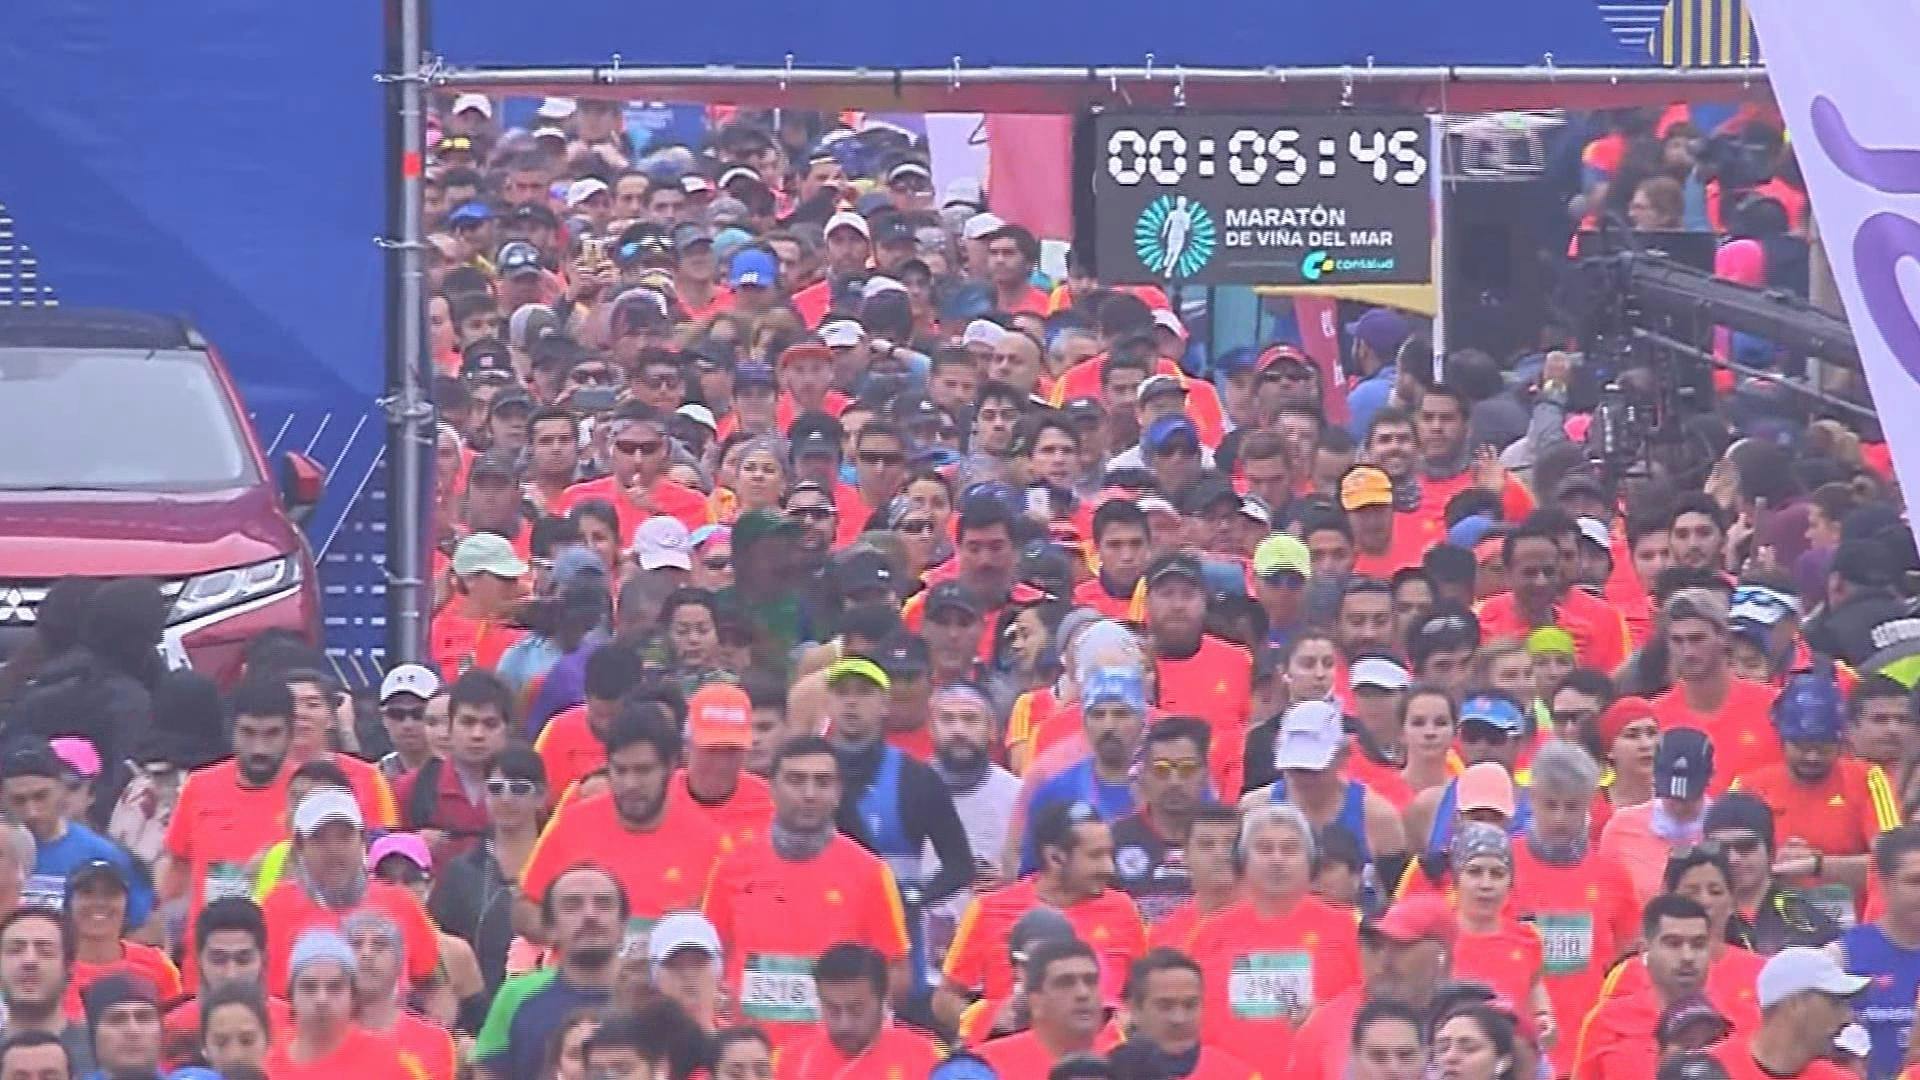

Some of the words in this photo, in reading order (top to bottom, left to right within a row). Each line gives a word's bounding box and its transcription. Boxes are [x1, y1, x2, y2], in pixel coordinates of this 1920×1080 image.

[1107, 130, 1427, 185] 00:05:45
[1225, 203, 1346, 226] MARATÓN
[1225, 230, 1252, 247] DE
[1256, 228, 1305, 247] VIÑA
[1308, 230, 1346, 247] DEL
[1349, 230, 1393, 247] MAR
[1336, 257, 1395, 272] consalud
